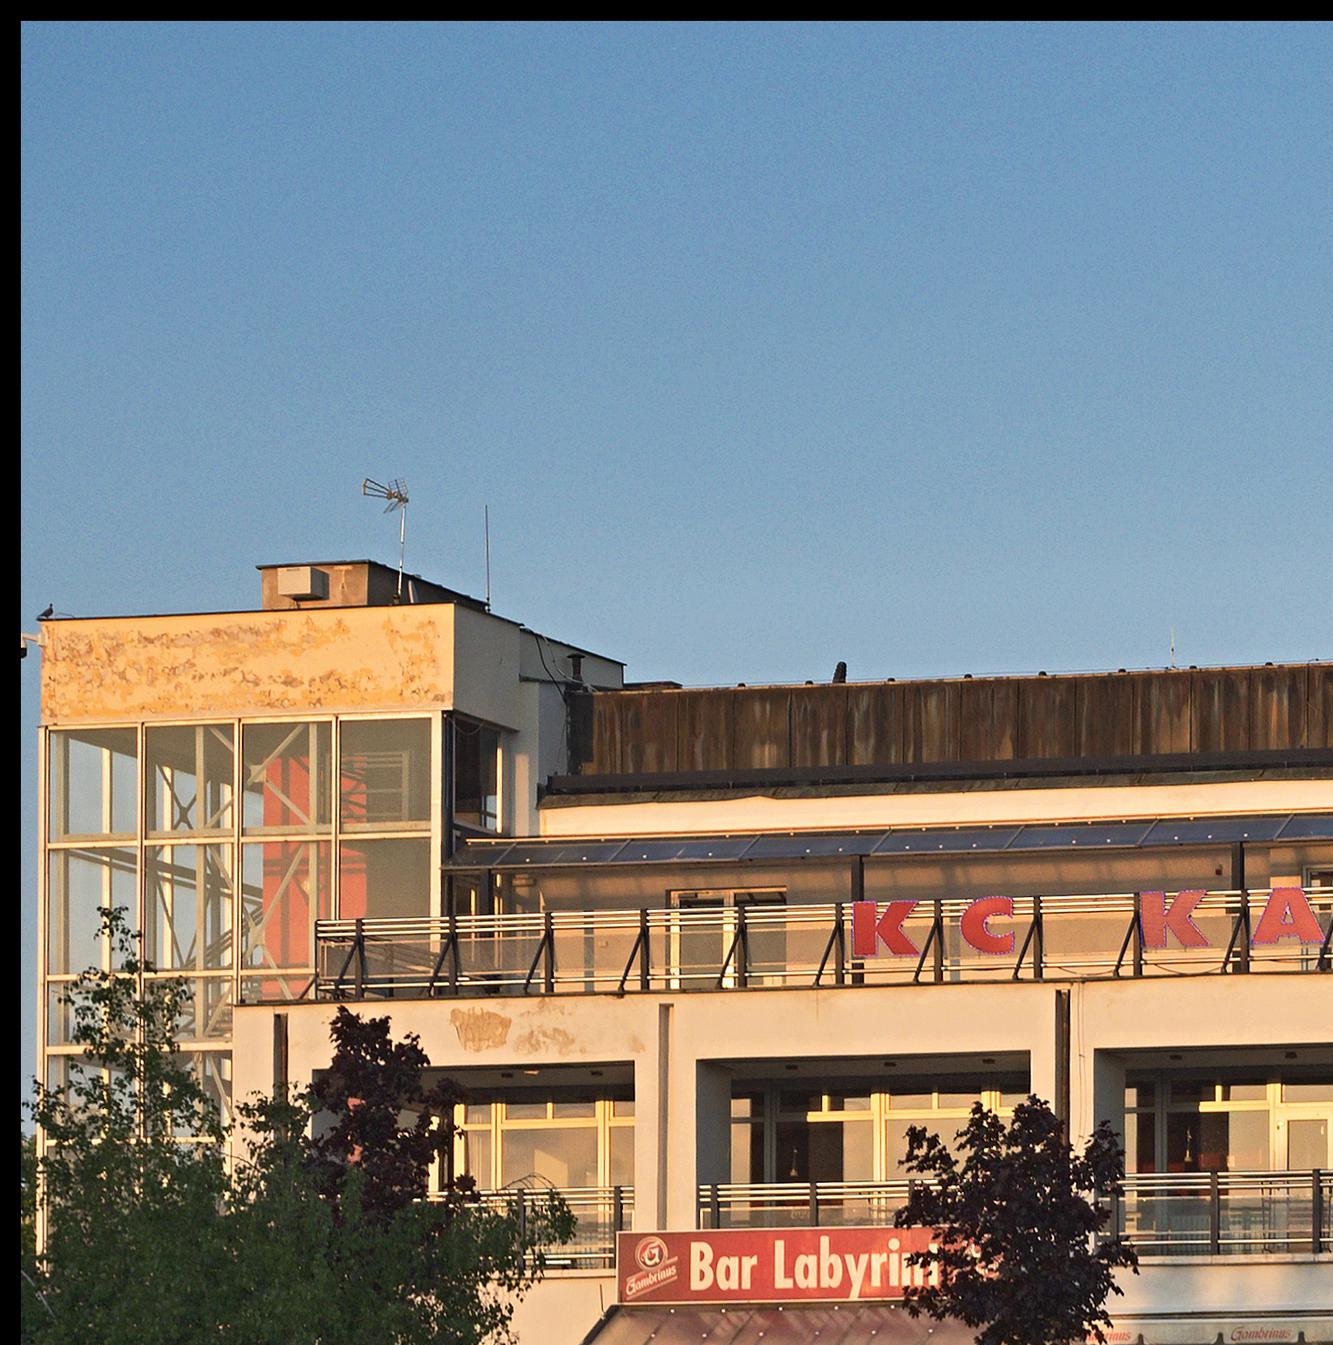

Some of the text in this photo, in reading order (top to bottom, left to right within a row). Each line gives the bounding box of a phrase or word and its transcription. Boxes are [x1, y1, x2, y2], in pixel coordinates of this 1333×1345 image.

[851, 895, 1016, 958] KC
[625, 1265, 678, 1296] Gambrinus
[690, 1241, 758, 1291] Bar
[1231, 1326, 1291, 1342] Gambrinus
